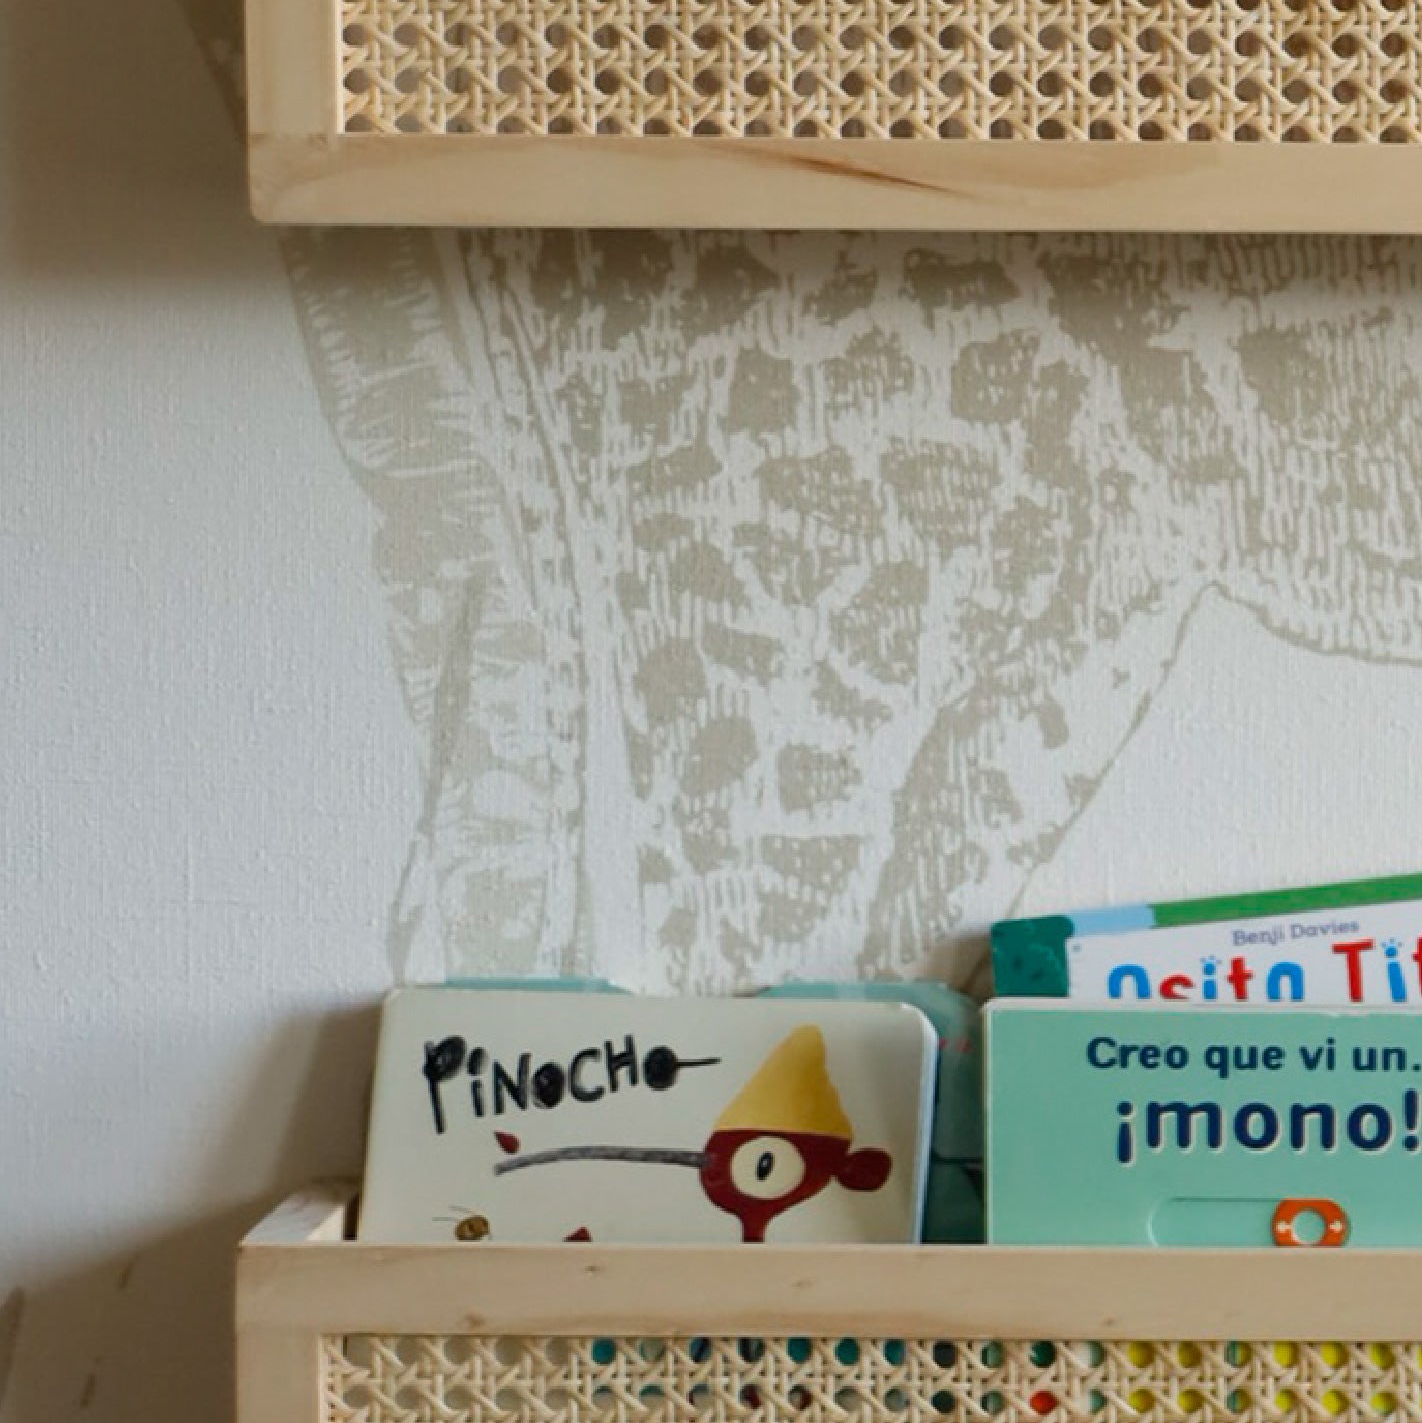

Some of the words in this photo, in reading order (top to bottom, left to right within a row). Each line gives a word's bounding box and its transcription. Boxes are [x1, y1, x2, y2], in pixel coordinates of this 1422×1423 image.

[1231, 928, 1287, 947] Benji
[1290, 919, 1360, 941] Davies
[1086, 1036, 1190, 1070] Creo
[1203, 1044, 1286, 1080] que
[1299, 1037, 1337, 1071] vi
[1115, 1087, 1422, 1166] ¡mono!
